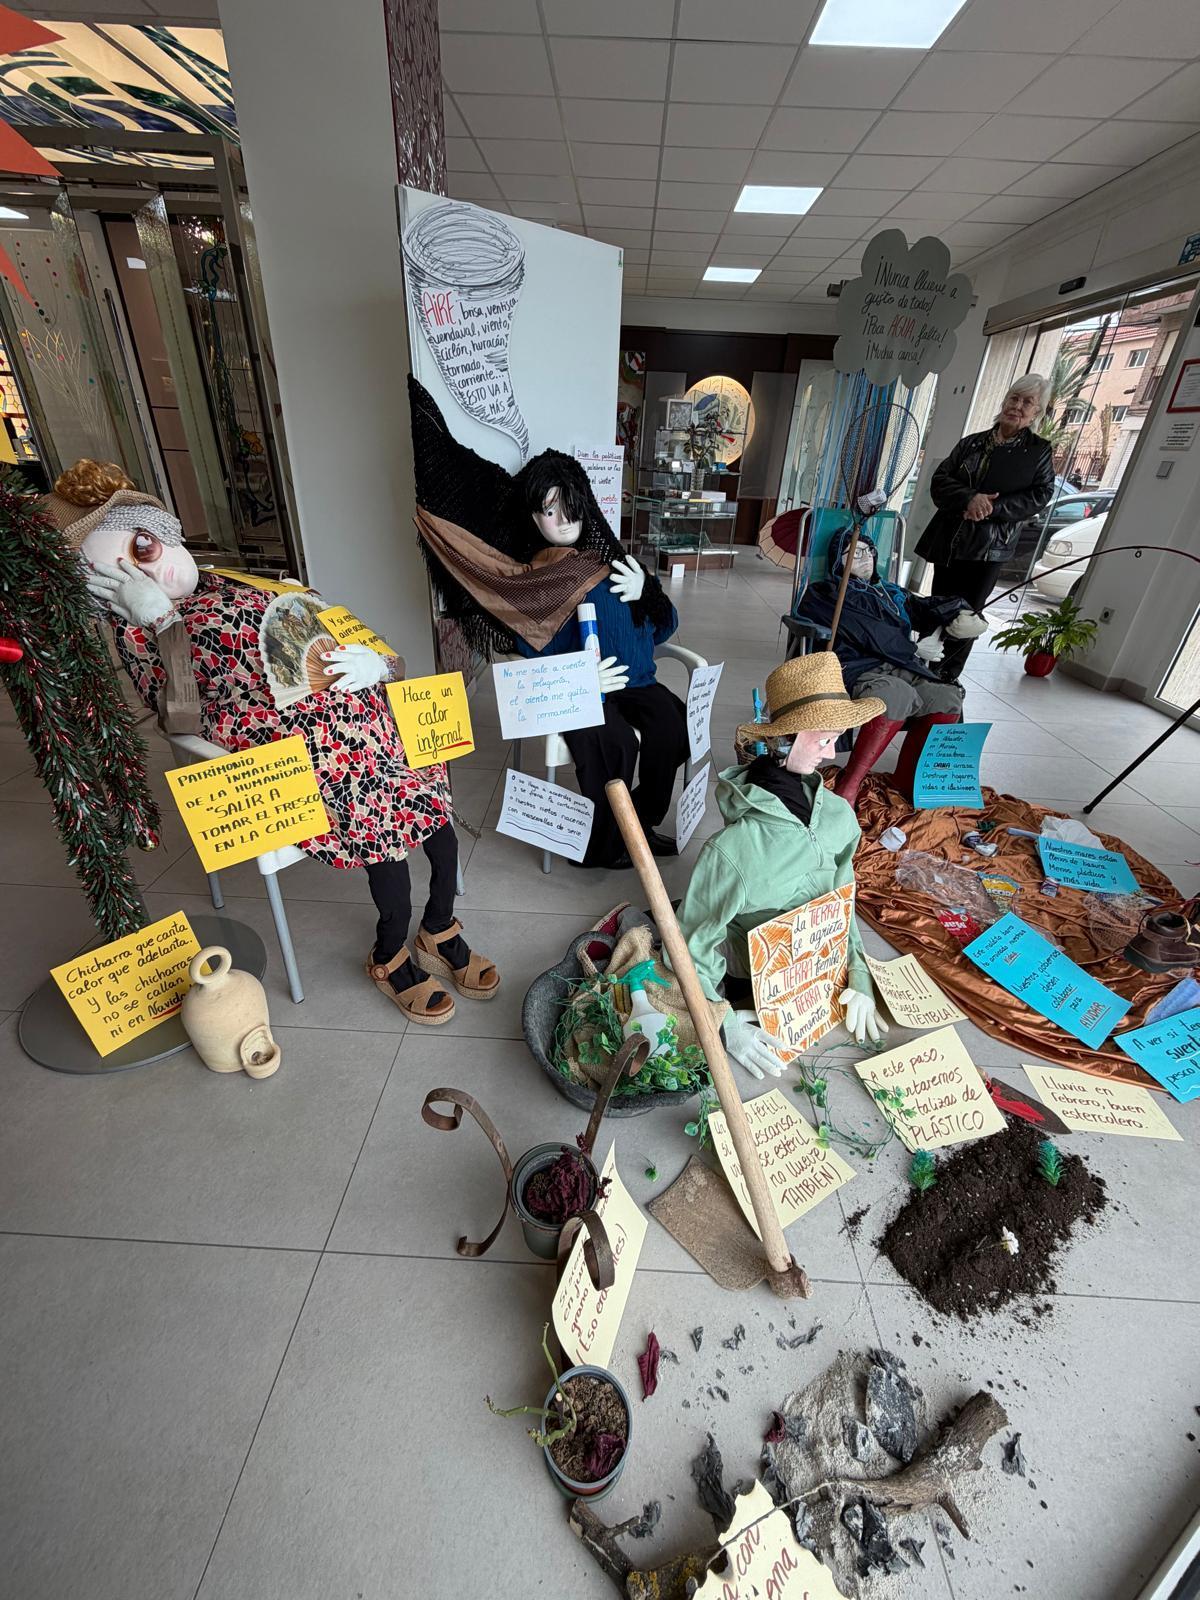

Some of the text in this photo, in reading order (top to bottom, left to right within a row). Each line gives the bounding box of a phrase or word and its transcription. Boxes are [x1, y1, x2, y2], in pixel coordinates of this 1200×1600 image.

[875, 256, 957, 299] ¡Nunca llueve a
[460, 302, 487, 319] brisa,
[861, 291, 894, 314] gusto
[898, 295, 908, 308] de
[432, 319, 510, 345] vendaval, viento,
[863, 313, 948, 348] ¡Poca AGUA, falta!
[441, 334, 508, 361] ciclón, huracán,
[866, 340, 893, 361] ¡Mucha
[445, 359, 485, 376] tornado,
[457, 371, 504, 389] corriente...
[466, 382, 509, 403] ESTO VA A
[489, 401, 506, 414] MÁS
[328, 618, 336, 627] Y
[339, 628, 354, 638] aire
[504, 668, 512, 678] No
[532, 664, 547, 674] sale
[402, 686, 453, 703] Hace un
[517, 680, 525, 689] la
[510, 696, 518, 705] el
[525, 693, 549, 704] viento
[568, 687, 589, 701] quita
[418, 702, 448, 725] calor
[518, 704, 581, 723] la permanente.
[416, 721, 463, 759] infernal
[186, 797, 204, 808] DE
[210, 790, 227, 802] LA
[269, 788, 281, 800] A
[198, 793, 320, 840] TOMAR EL FRESCO
[214, 839, 235, 852] EN
[240, 830, 259, 843] LA
[1074, 851, 1096, 859] mares
[810, 918, 843, 948] agrieta
[66, 921, 188, 983] Chicharra que canta
[68, 939, 193, 999] calor que adelanta.
[1011, 950, 1061, 994] Nuestros gobiernos
[1041, 976, 1060, 993] deben
[103, 976, 185, 1024] no se callan
[106, 991, 129, 1005] las
[110, 1014, 145, 1038] ni en
[788, 1005, 829, 1046] lamenta
[1132, 1029, 1178, 1050] A ver si
[870, 1048, 945, 1084] A este paso,
[962, 1084, 983, 1103] de
[1041, 1075, 1114, 1096] Lluvia en
[752, 1096, 787, 1123] fértil,
[1051, 1091, 1146, 1114] febrero, buen
[910, 1110, 984, 1145] PLÁSTICO
[1062, 1108, 1149, 1129] estercolero.
[774, 1129, 814, 1159] estéril.
[770, 1170, 787, 1188] no
[786, 1147, 826, 1178] llueve
[781, 1161, 842, 1209] TAMBIÉN)
